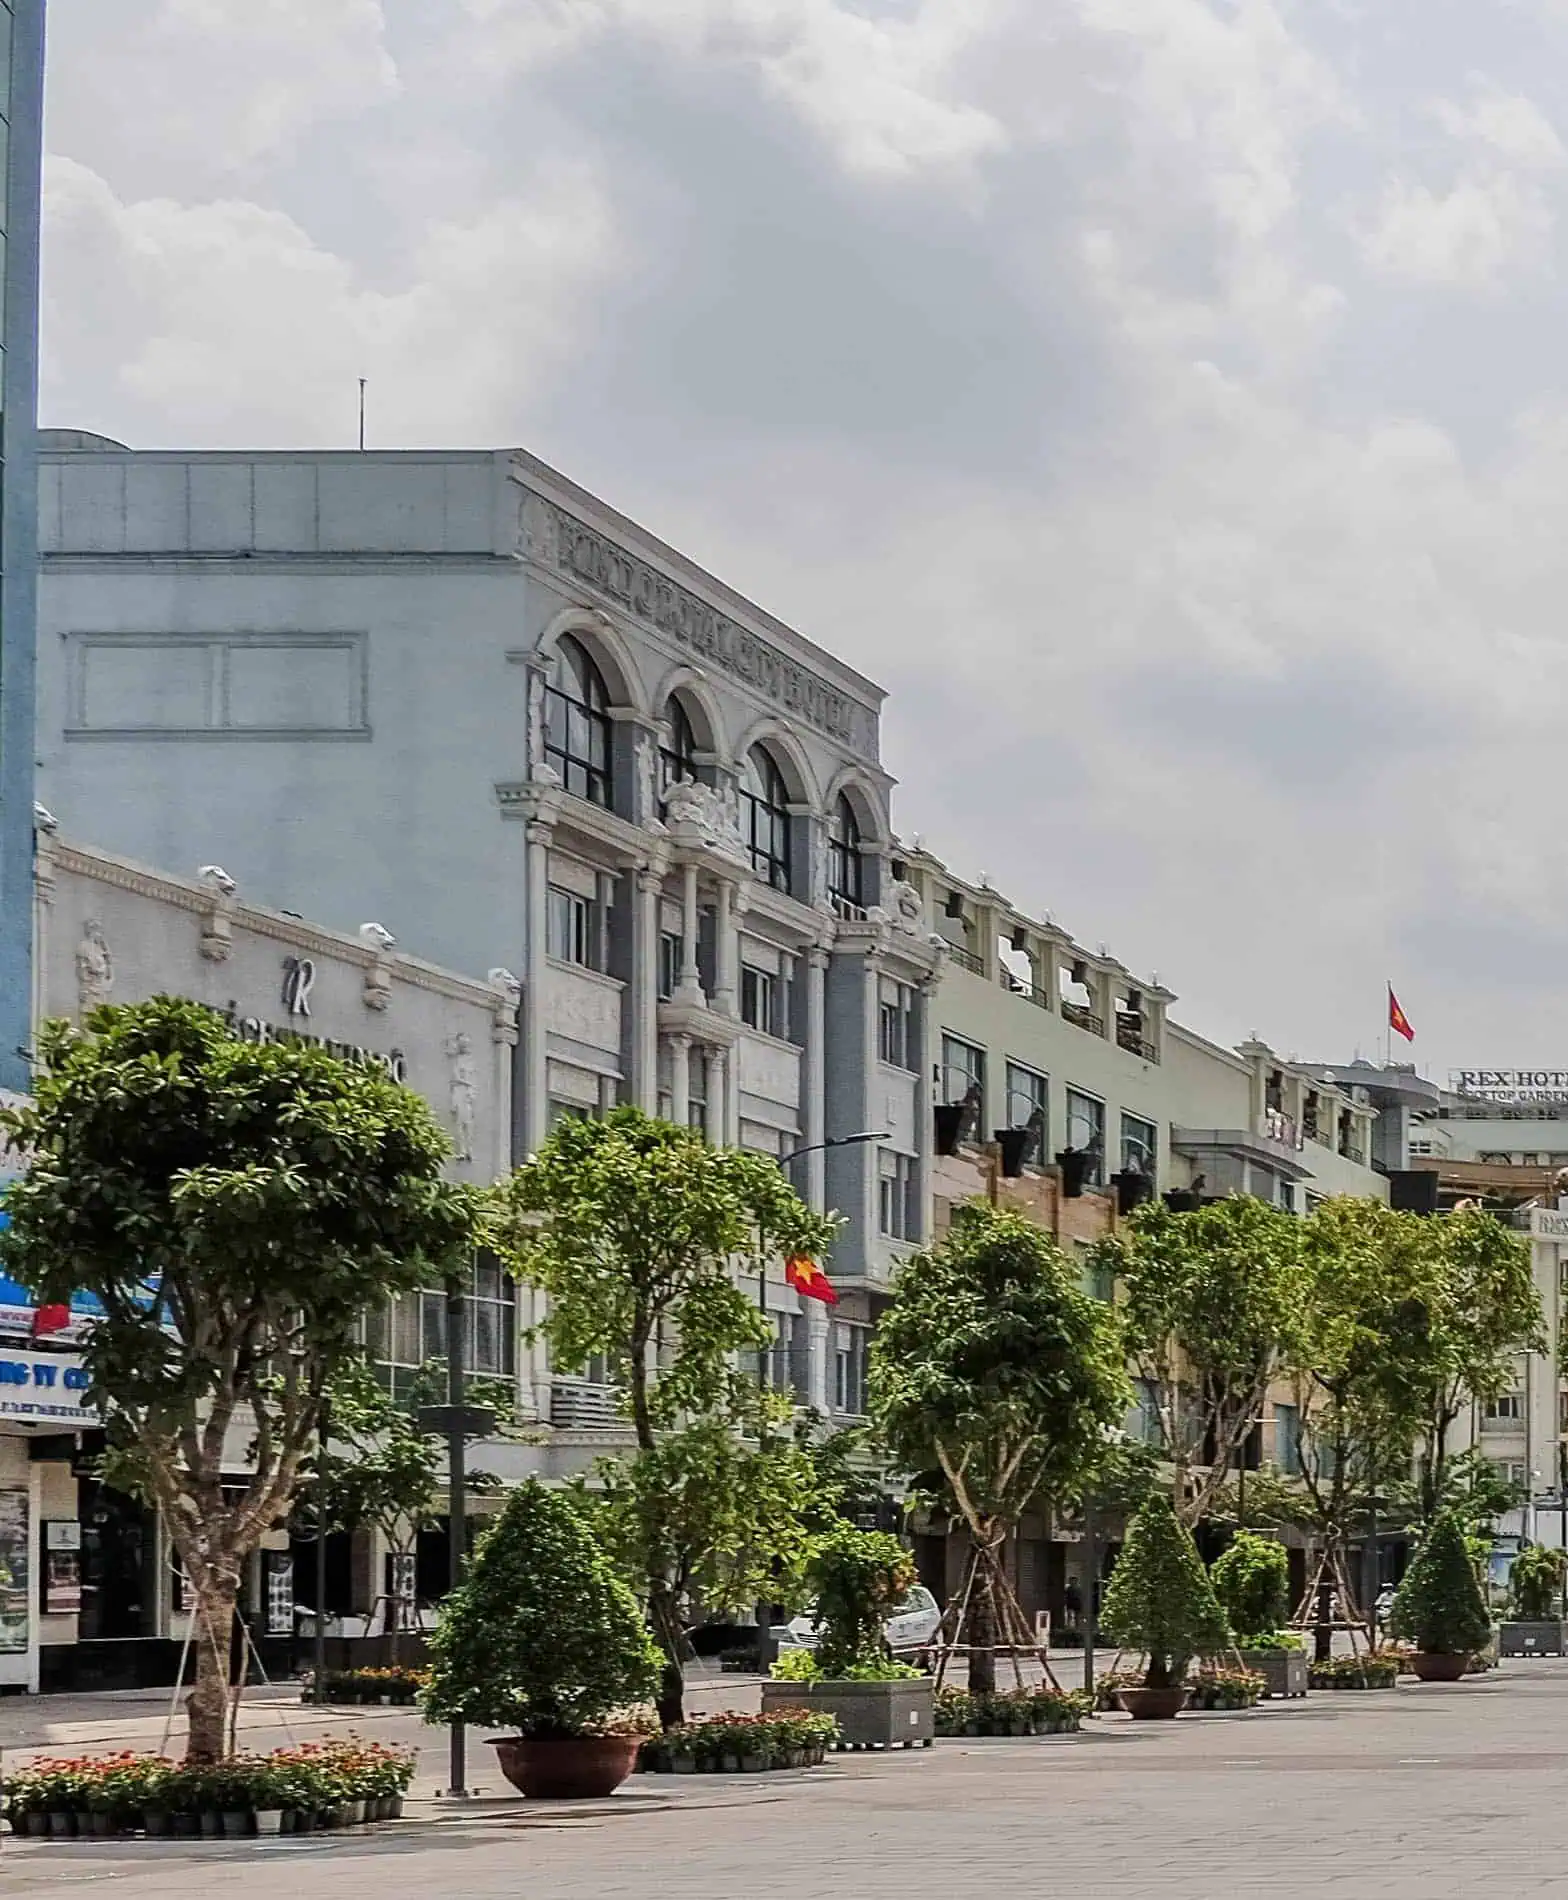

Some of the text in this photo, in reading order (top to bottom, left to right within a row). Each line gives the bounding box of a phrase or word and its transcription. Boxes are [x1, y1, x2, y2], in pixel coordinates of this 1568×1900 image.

[1461, 1071, 1510, 1087] REX
[1519, 1090, 1568, 1101] GARDEN
[33, 1363, 58, 1387] TY
